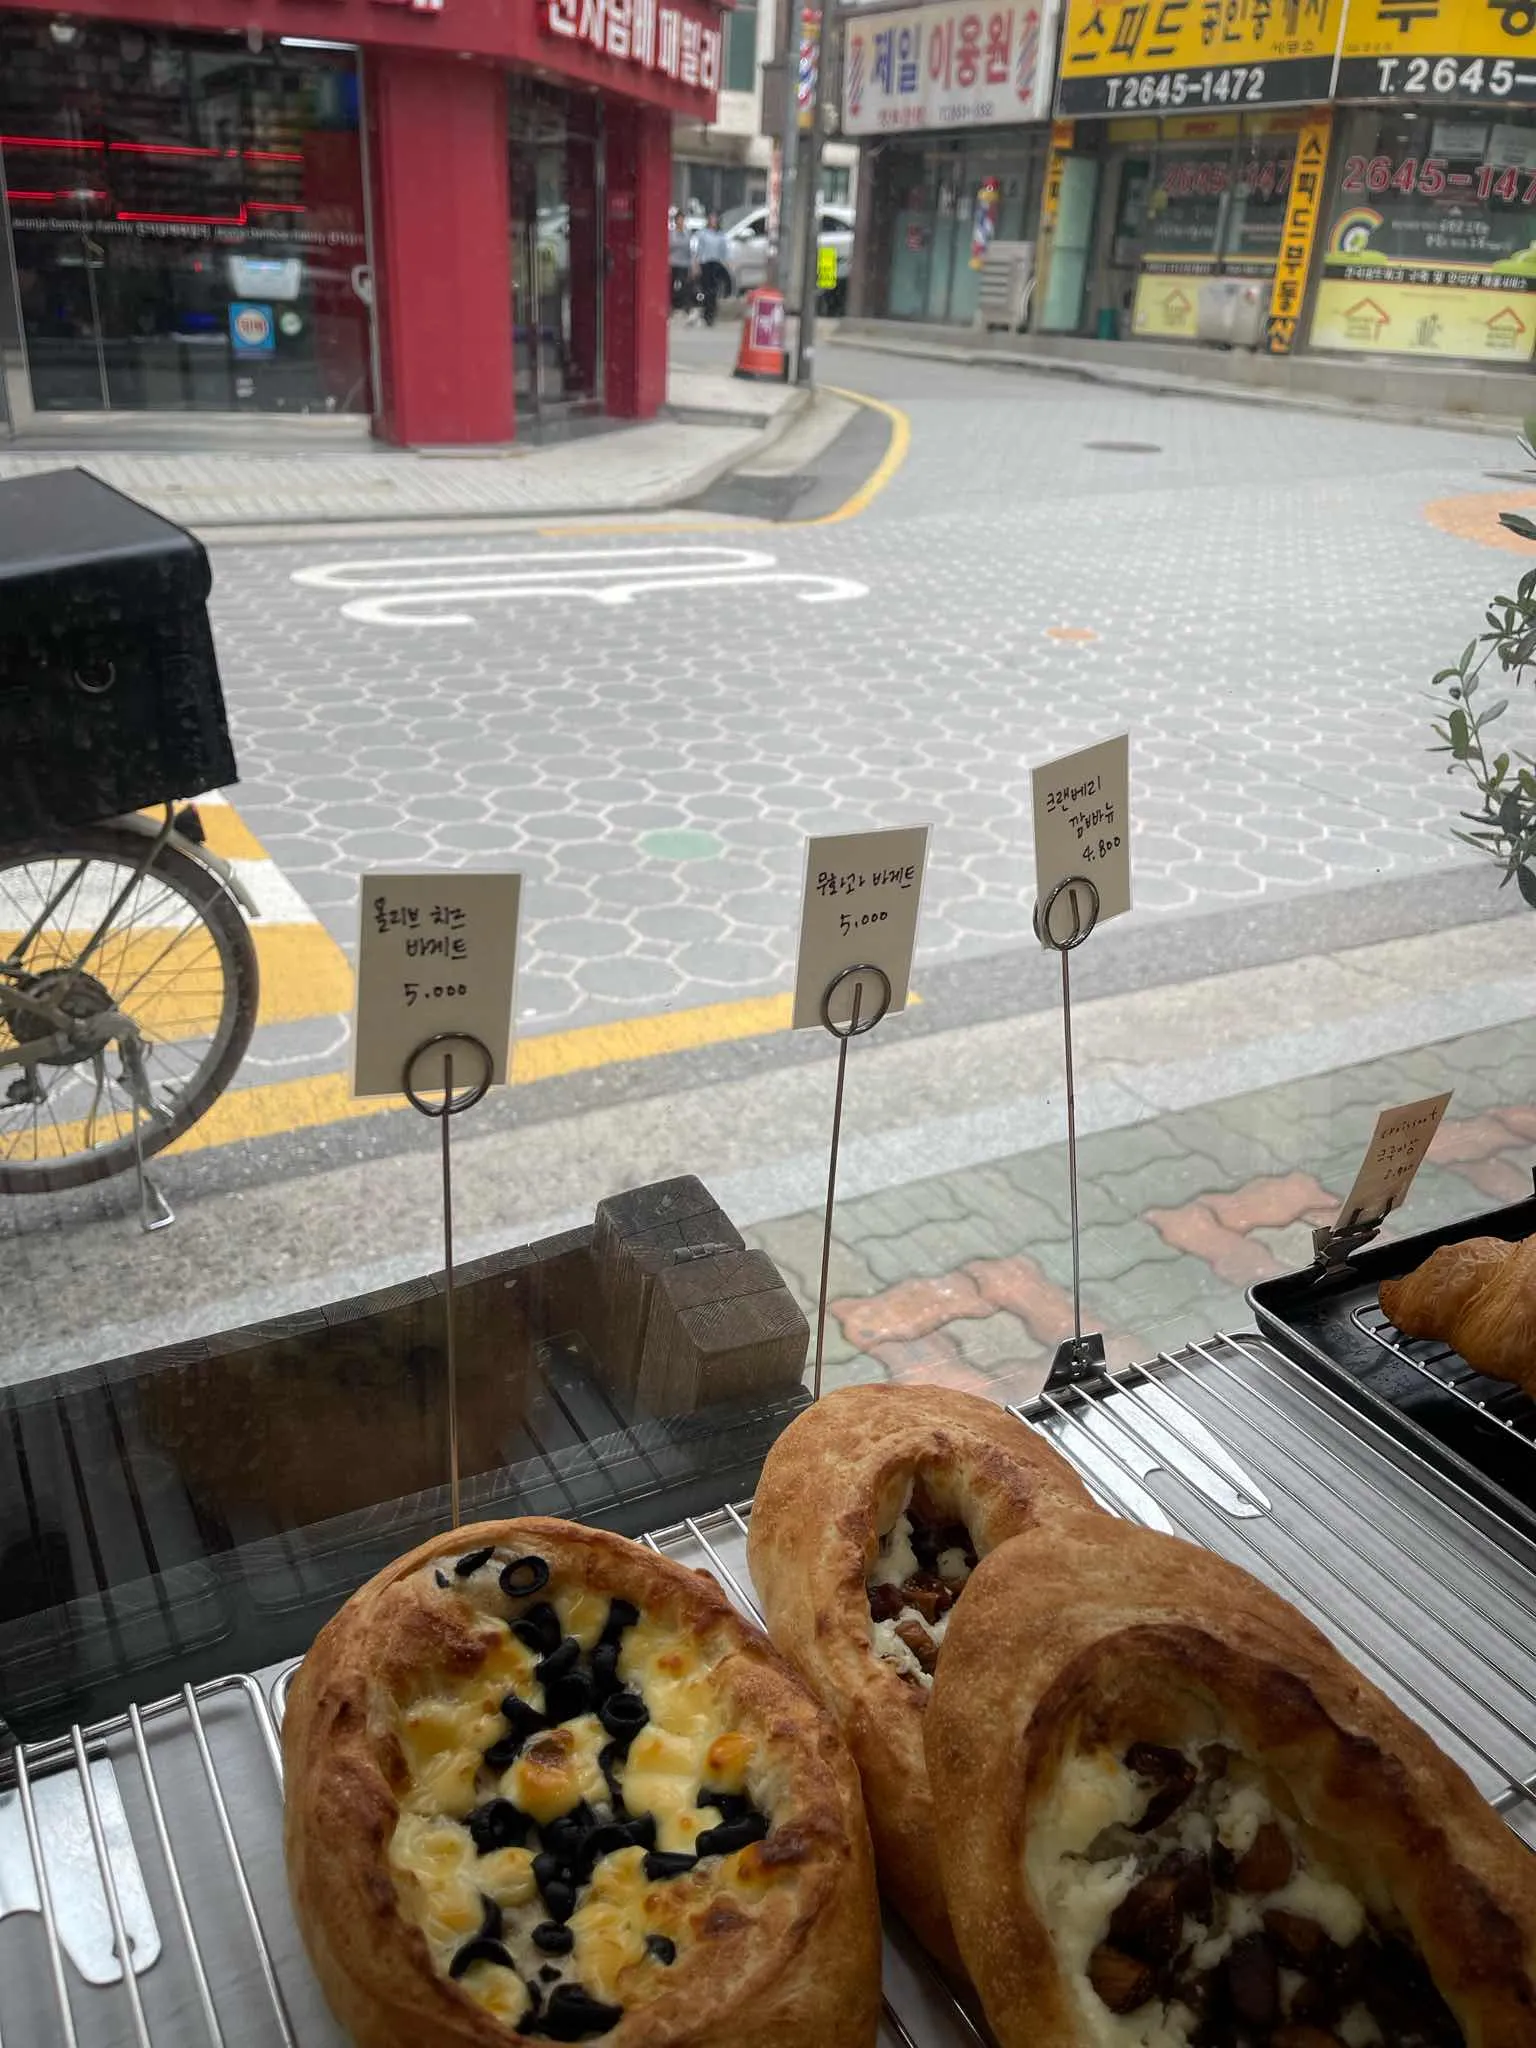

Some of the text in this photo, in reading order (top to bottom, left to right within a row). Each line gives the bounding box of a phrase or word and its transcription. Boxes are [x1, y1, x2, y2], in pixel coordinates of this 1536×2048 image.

[657, 8, 721, 93] 패밀리
[1070, 2, 1190, 62] 스피드
[872, 8, 1014, 95] 제일 이용원
[1046, 775, 1101, 812] 크랜베리
[1068, 802, 1114, 839] 깜빠뉴
[1082, 836, 1121, 861] 4.800
[816, 865, 915, 896] 무화과 바게트
[374, 896, 468, 933] 올리브 치즈
[405, 936, 468, 960] 바게트
